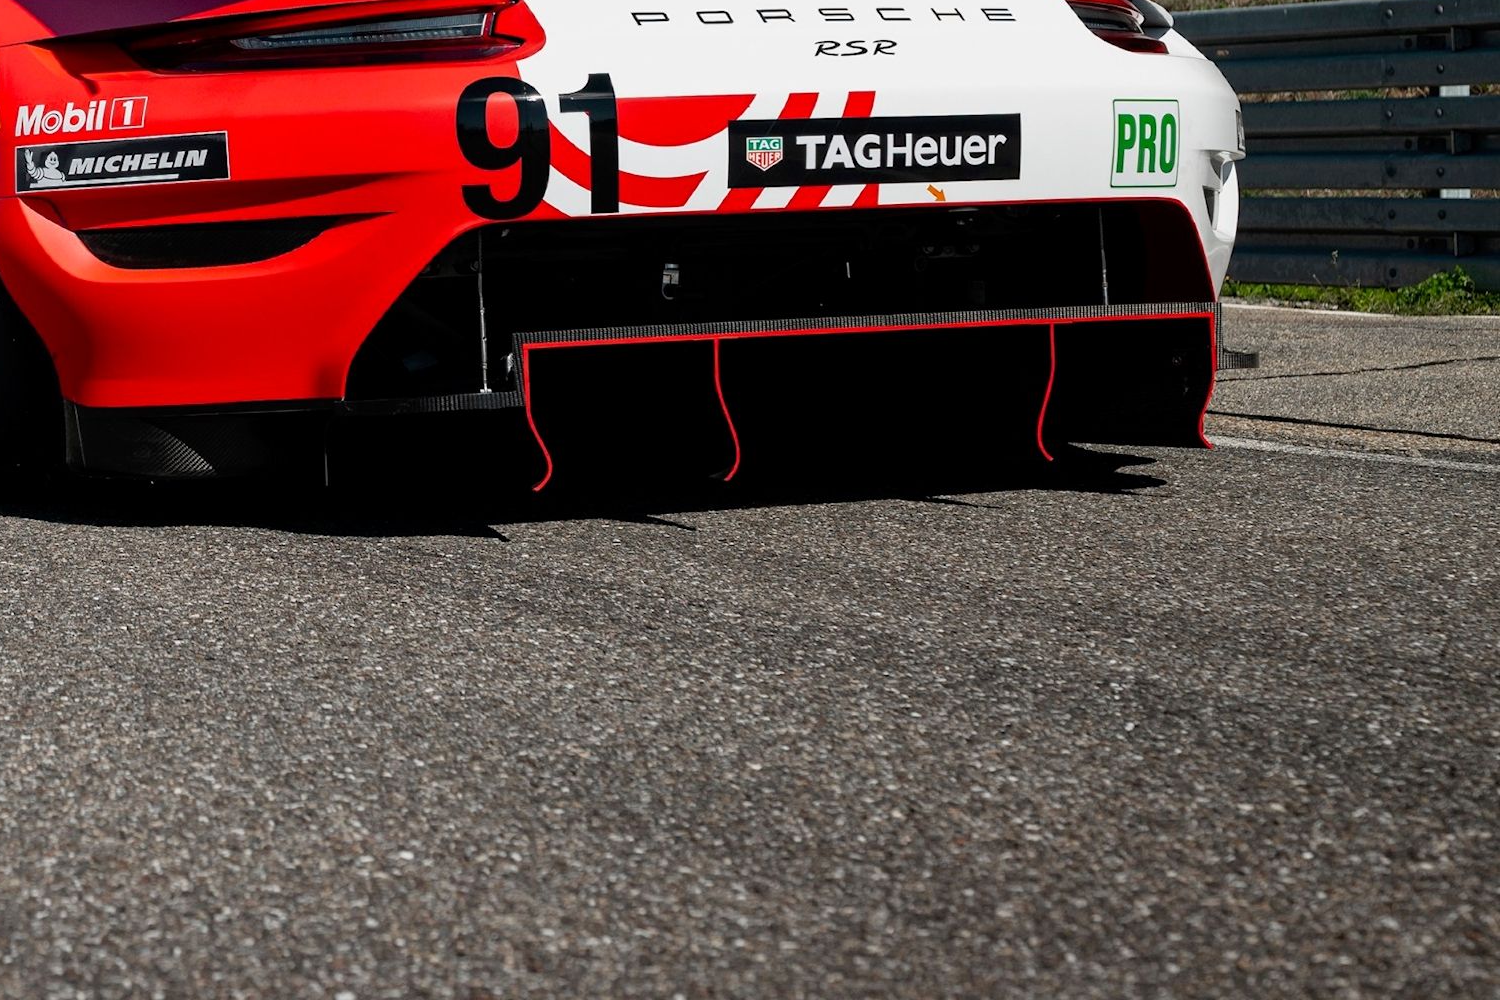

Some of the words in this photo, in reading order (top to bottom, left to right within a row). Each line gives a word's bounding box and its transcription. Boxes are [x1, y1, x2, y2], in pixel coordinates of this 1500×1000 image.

[630, 7, 1016, 26] PORSCHE
[814, 39, 898, 57] RSR
[14, 100, 106, 137] Mobil
[456, 73, 620, 221] 91
[750, 139, 779, 150] TAG
[1117, 110, 1178, 174] PRO
[68, 149, 209, 176] MICHELIN
[749, 152, 781, 168] HEUER
